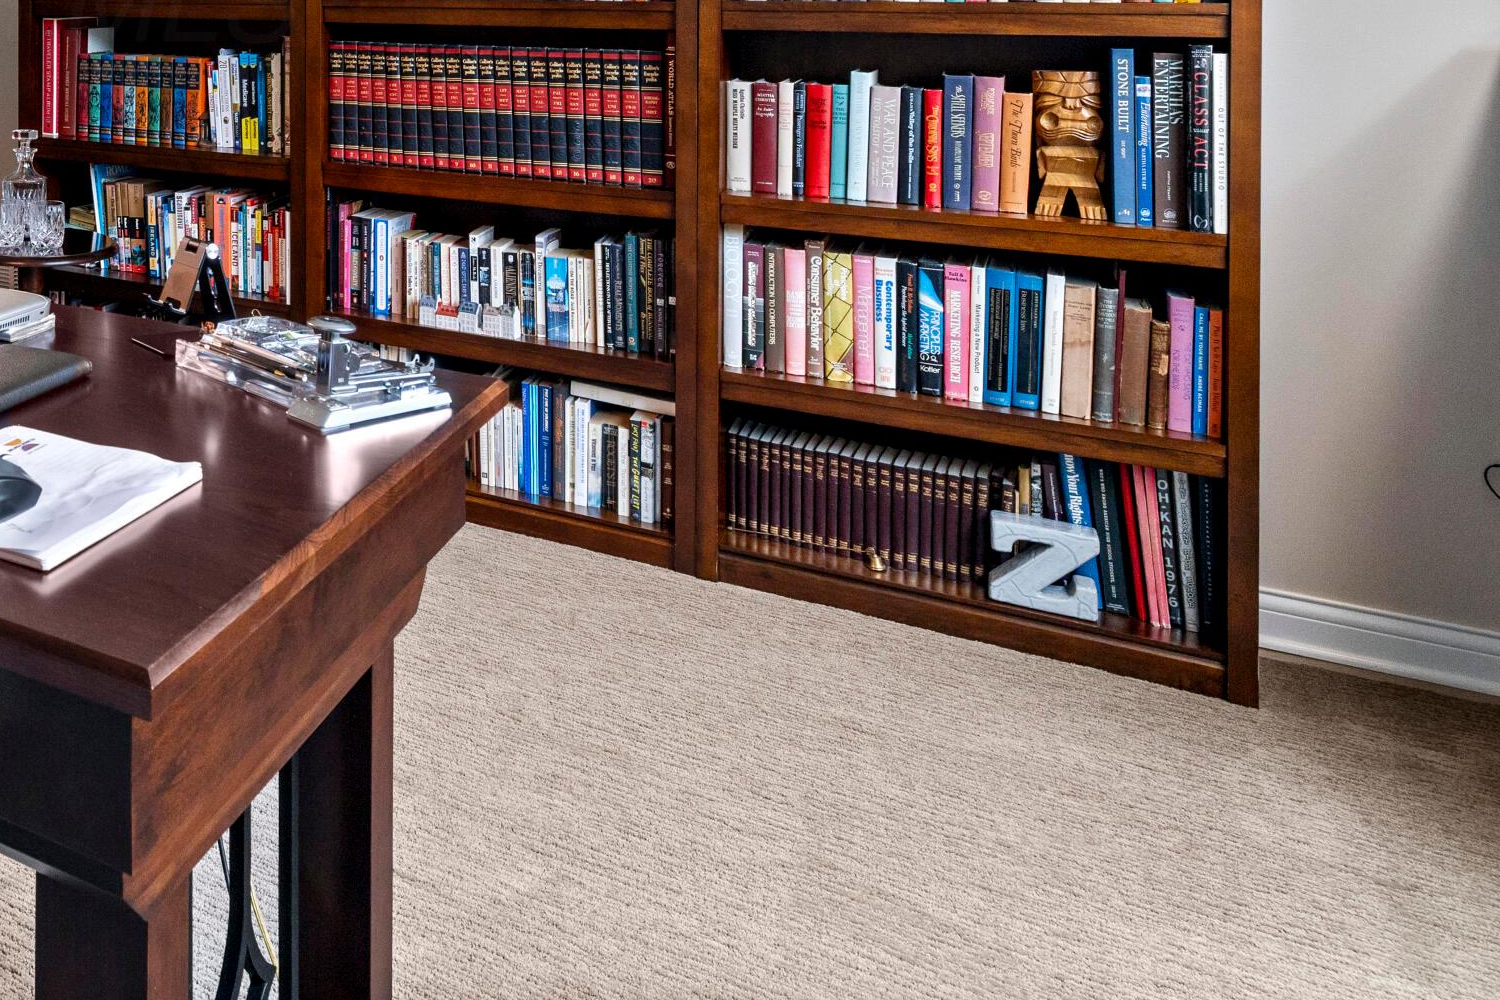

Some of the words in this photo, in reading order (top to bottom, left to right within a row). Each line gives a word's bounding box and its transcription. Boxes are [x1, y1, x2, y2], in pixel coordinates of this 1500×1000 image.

[1117, 58, 1129, 96] STONE
[1169, 59, 1183, 124] MARTHA'S
[883, 99, 896, 125] WAR
[1010, 100, 1023, 117] The
[1117, 100, 1129, 133] BUILT
[1155, 59, 1169, 158] ENTERTAINING
[1194, 72, 1208, 126] CLASS
[883, 128, 896, 152] AND
[1010, 120, 1023, 146] Thorn
[1138, 102, 1150, 147] Entertaining
[1218, 128, 1224, 138] OF
[883, 155, 896, 188] PEACE
[1010, 147, 1023, 168] Birds
[1194, 136, 1208, 169] ACT
[615, 280, 623, 297] REAL
[726, 236, 739, 303] BIOLOGY
[811, 256, 822, 305] Consumer
[615, 298, 623, 331] MOMENTS
[768, 299, 775, 307] TO
[855, 285, 872, 359] Management
[882, 280, 893, 351] Contemporary
[950, 290, 961, 337] MARKETING
[811, 307, 822, 351] Behavior
[920, 308, 929, 360] MARKETING
[931, 310, 941, 355] PRINCIPLES
[920, 365, 940, 374] Kotler
[950, 340, 961, 383] RESEARCH
[1067, 474, 1080, 495] Your
[1068, 495, 1084, 525] Rights
[1157, 479, 1174, 549] OH-KAN
[989, 510, 1100, 621] Z
[1164, 556, 1178, 608] 1976
